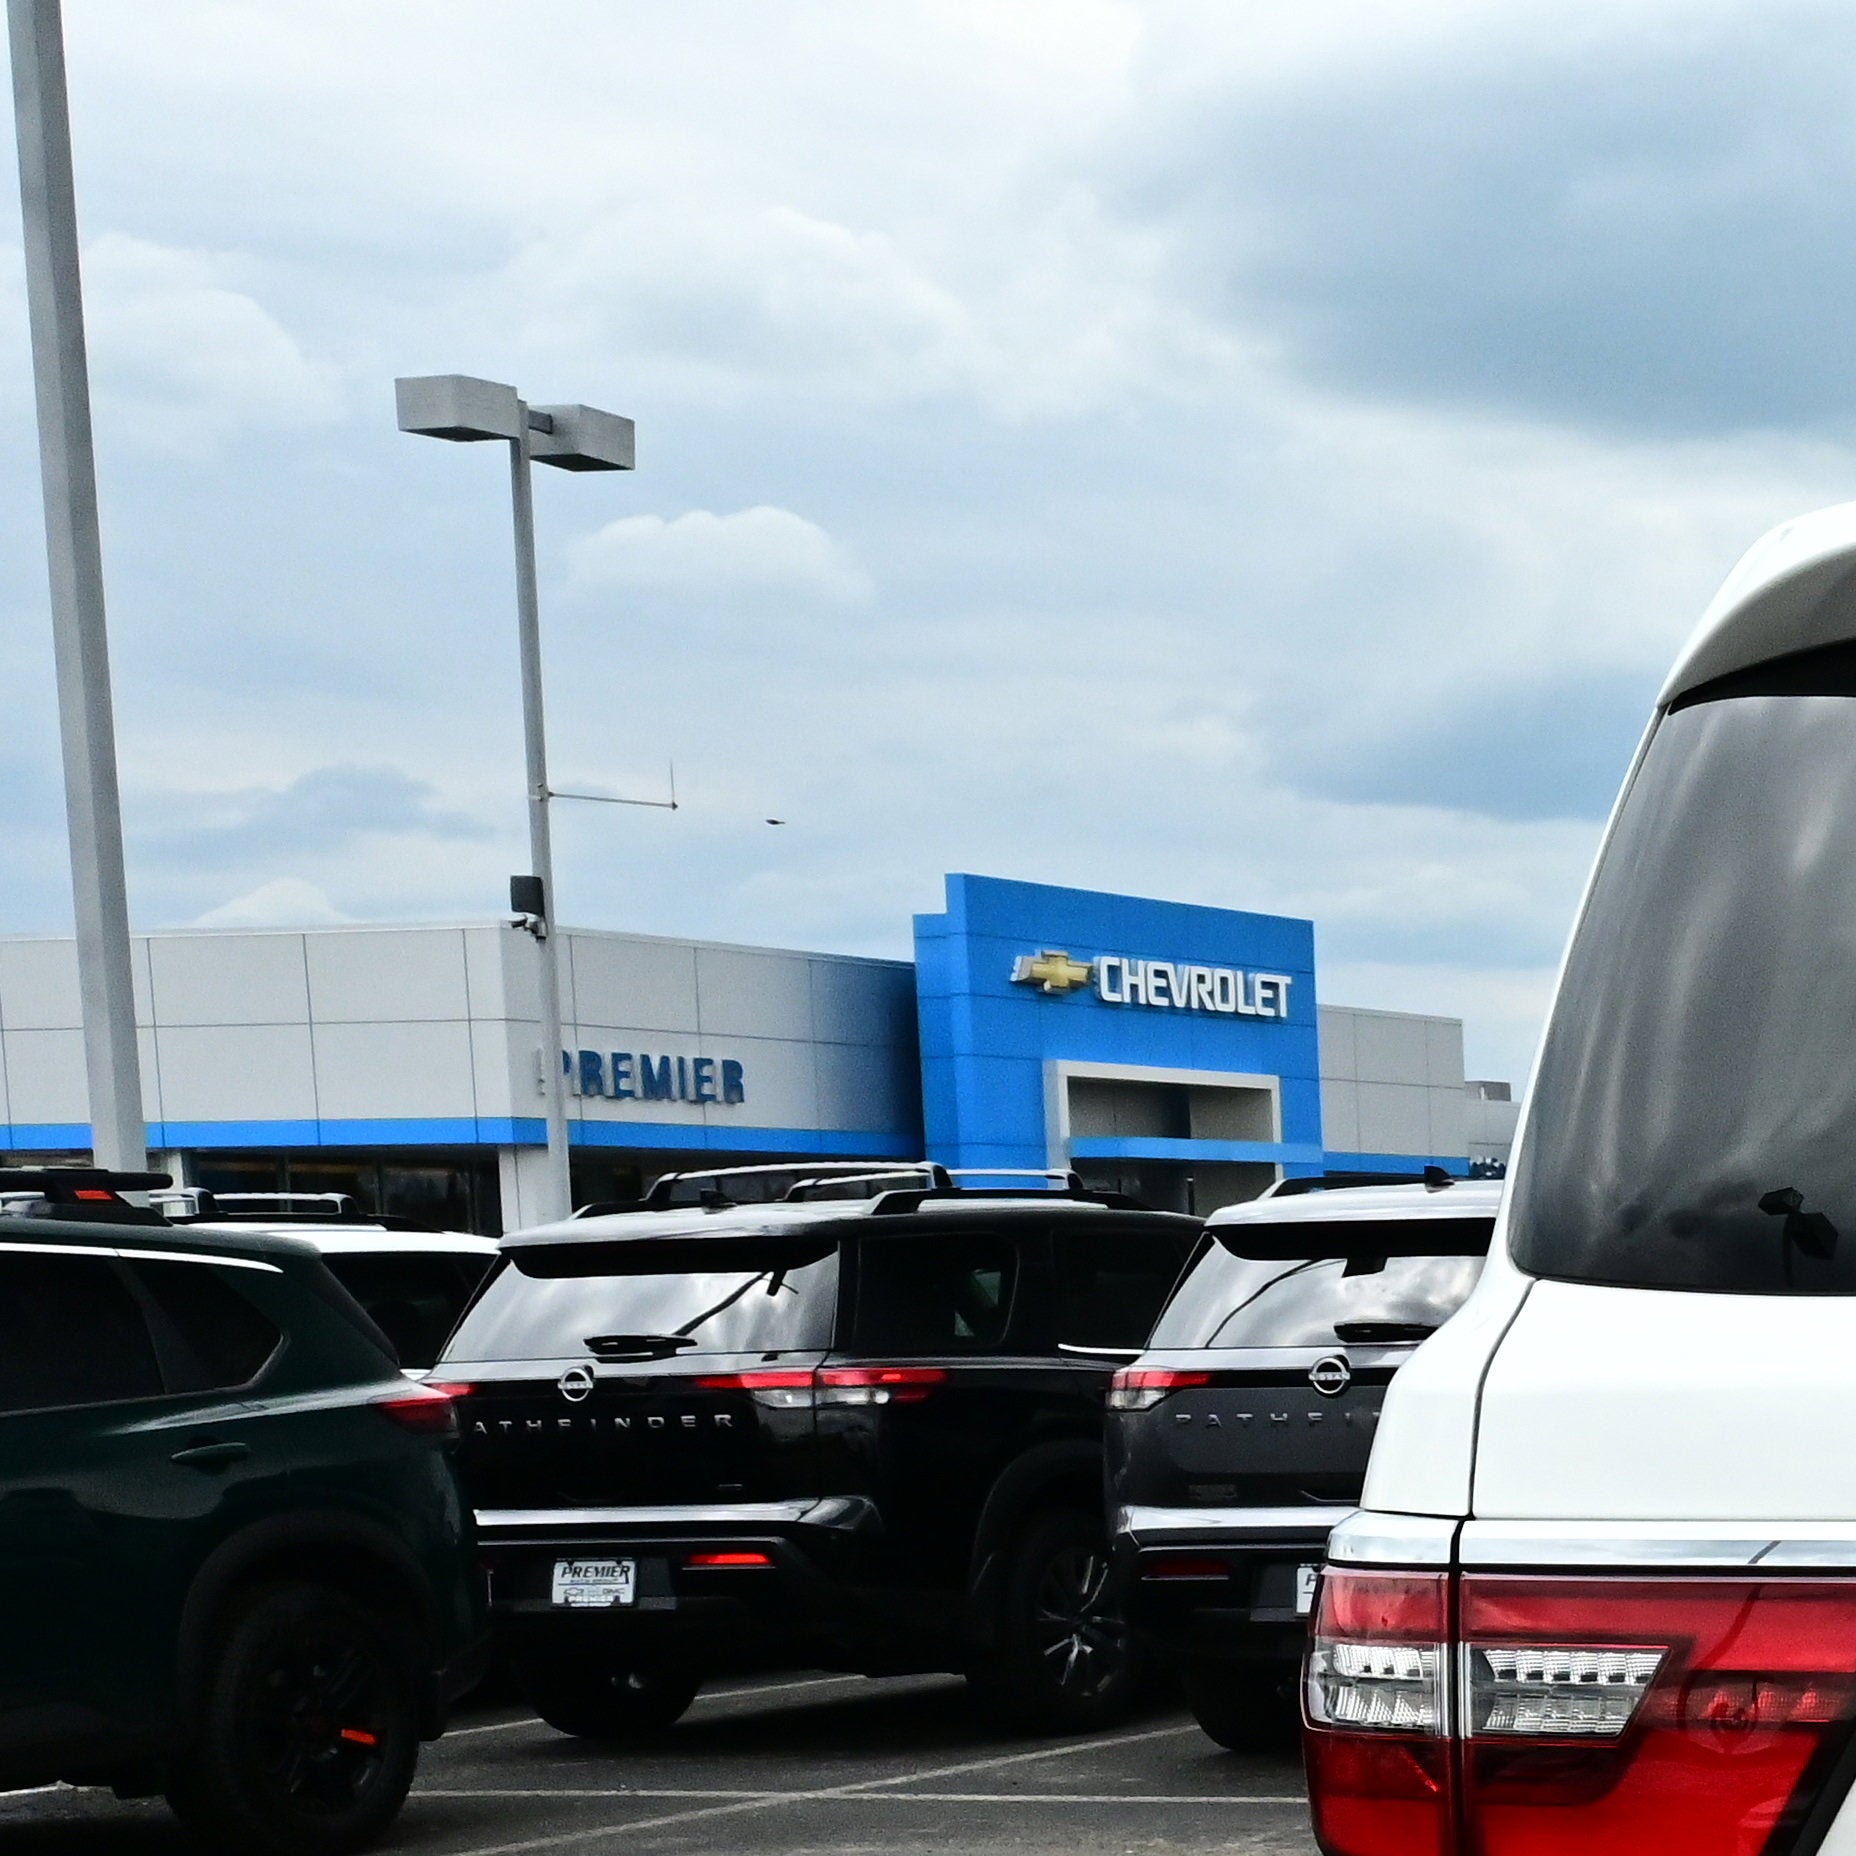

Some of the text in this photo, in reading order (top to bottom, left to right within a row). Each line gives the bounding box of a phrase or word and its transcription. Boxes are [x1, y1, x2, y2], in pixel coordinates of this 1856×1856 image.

[1098, 956, 1292, 1018] CHEVROLET
[473, 1413, 733, 1434] ATHFINDER
[1175, 1411, 1381, 1428] PATHFI
[561, 1565, 631, 1579] PREMIER
